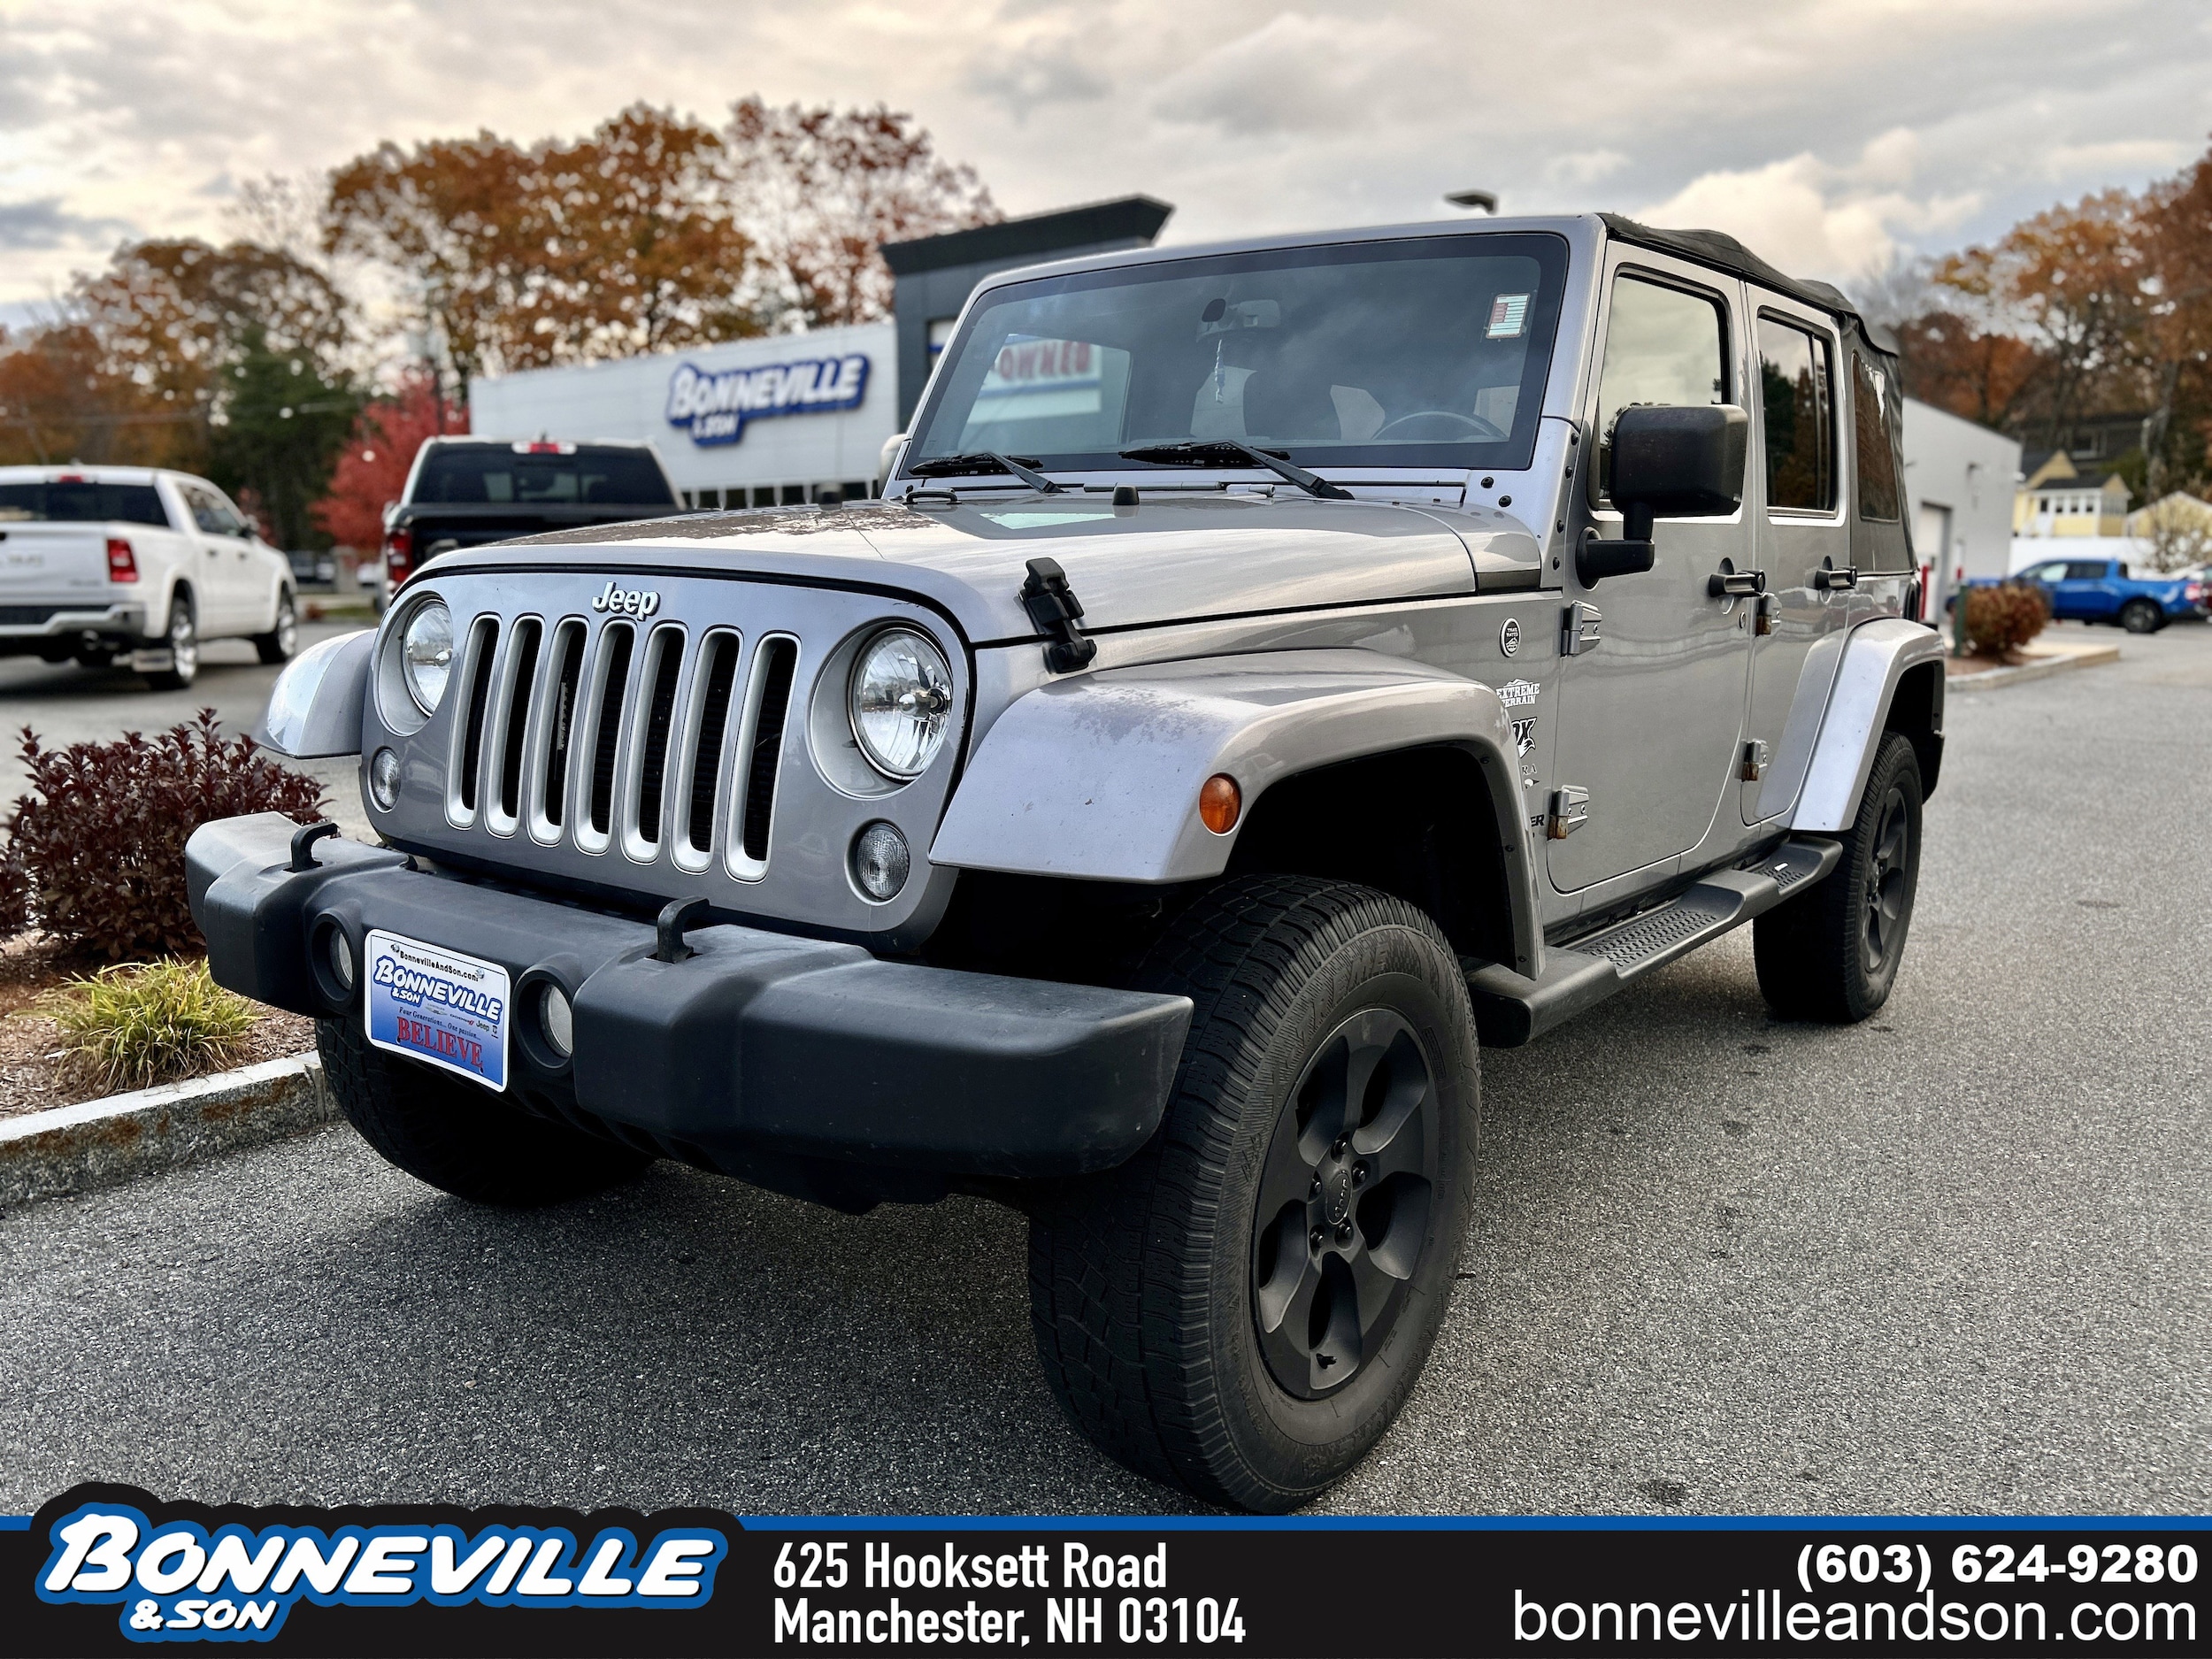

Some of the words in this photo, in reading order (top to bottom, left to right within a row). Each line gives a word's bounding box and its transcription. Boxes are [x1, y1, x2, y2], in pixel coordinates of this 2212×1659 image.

[670, 356, 866, 419] BONNEVILLE
[592, 581, 660, 621] Jeep
[1496, 682, 1540, 700] EXTREME
[1502, 695, 1537, 708] TERRAIN
[400, 951, 479, 982] BonnevilleAndSon.com
[374, 957, 502, 1022] BONNEVILLE
[399, 1006, 412, 1017] Four
[448, 1022, 457, 1032] One
[476, 1020, 489, 1032] Jeep
[397, 1017, 483, 1068] BELIEVE
